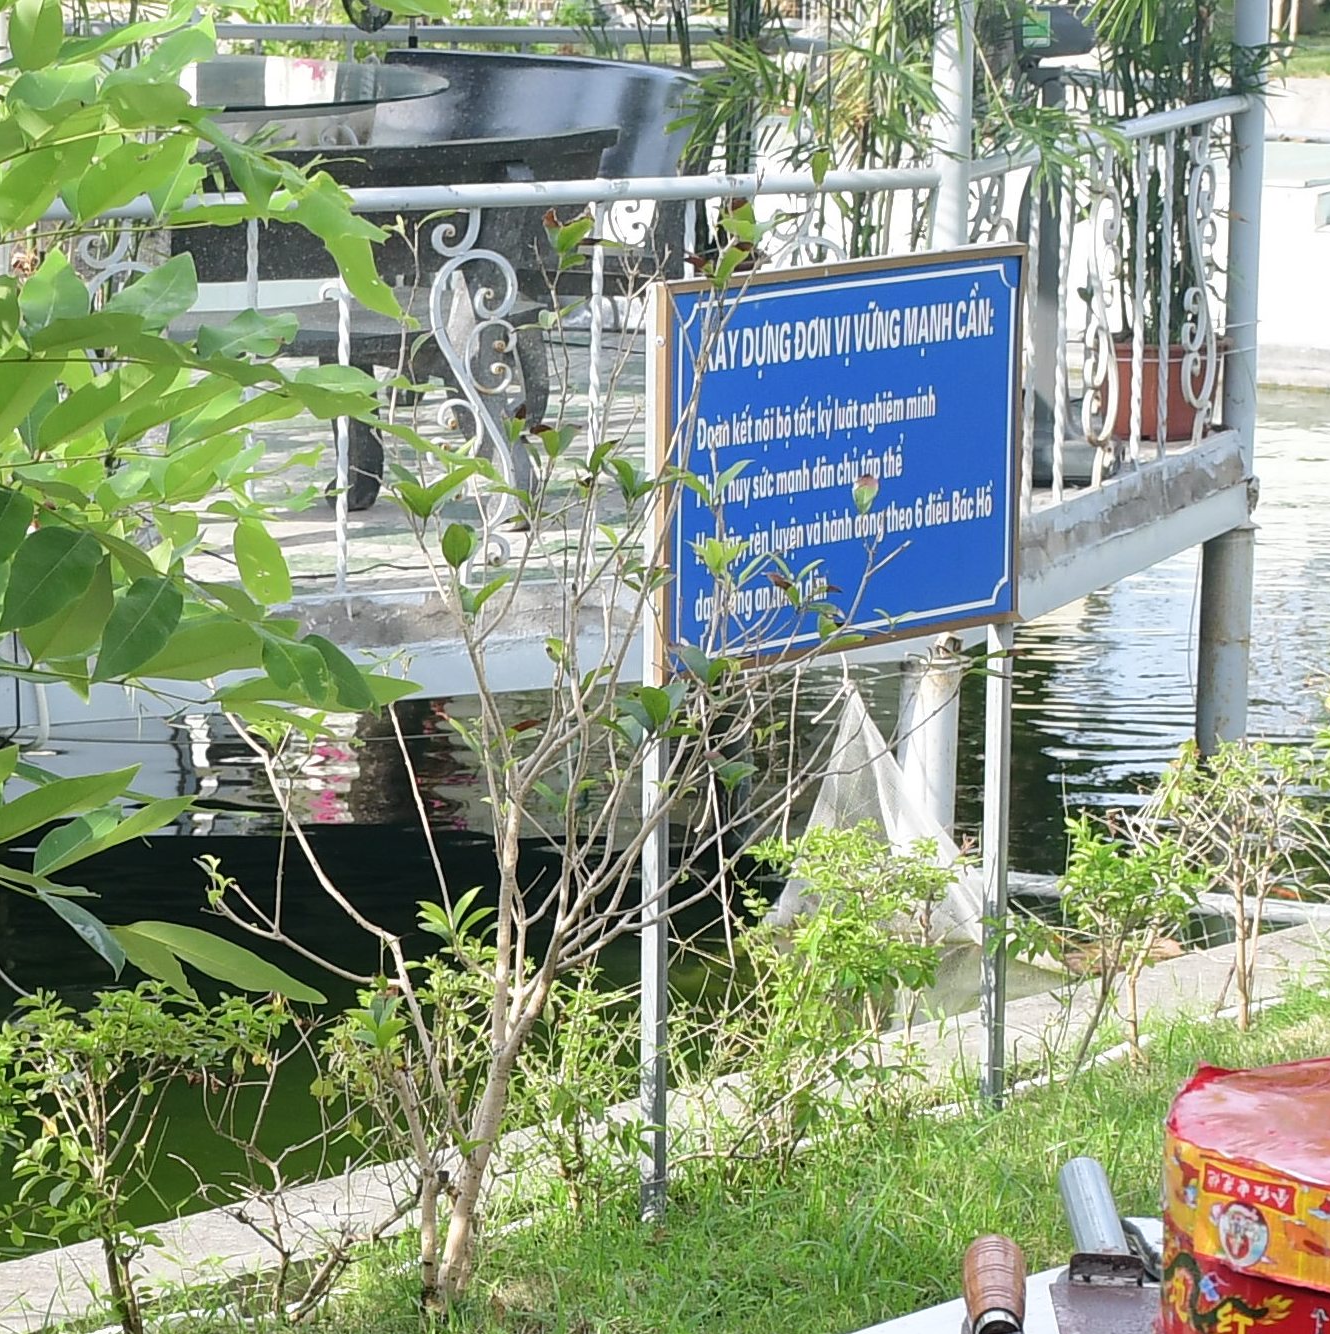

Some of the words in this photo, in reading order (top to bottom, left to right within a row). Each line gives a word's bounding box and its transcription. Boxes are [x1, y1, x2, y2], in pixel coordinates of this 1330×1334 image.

[742, 320, 791, 379] DỰNG
[794, 316, 831, 361] ĐƠN
[834, 315, 851, 367] VỊ
[854, 301, 900, 353] VỮNG
[903, 302, 953, 357] MẠNH
[955, 282, 994, 340] CẦN:
[732, 404, 752, 446] kết
[754, 407, 774, 452] nội
[776, 404, 791, 449] bộ
[834, 398, 858, 440] luật
[860, 390, 904, 434] nghiêm
[906, 385, 936, 420] minh
[752, 466, 774, 500] sức
[776, 459, 810, 505] mạnh
[812, 455, 834, 490] dân
[883, 432, 904, 479] thể
[749, 522, 769, 556] rèn
[771, 517, 804, 560] luyện
[806, 512, 821, 546] và
[823, 508, 852, 541] hành
[886, 500, 913, 533] theo
[915, 497, 923, 528] 6
[924, 487, 950, 527] điều
[951, 487, 974, 522] Bác
[976, 480, 993, 518] Hồ
[755, 586, 770, 611] an
